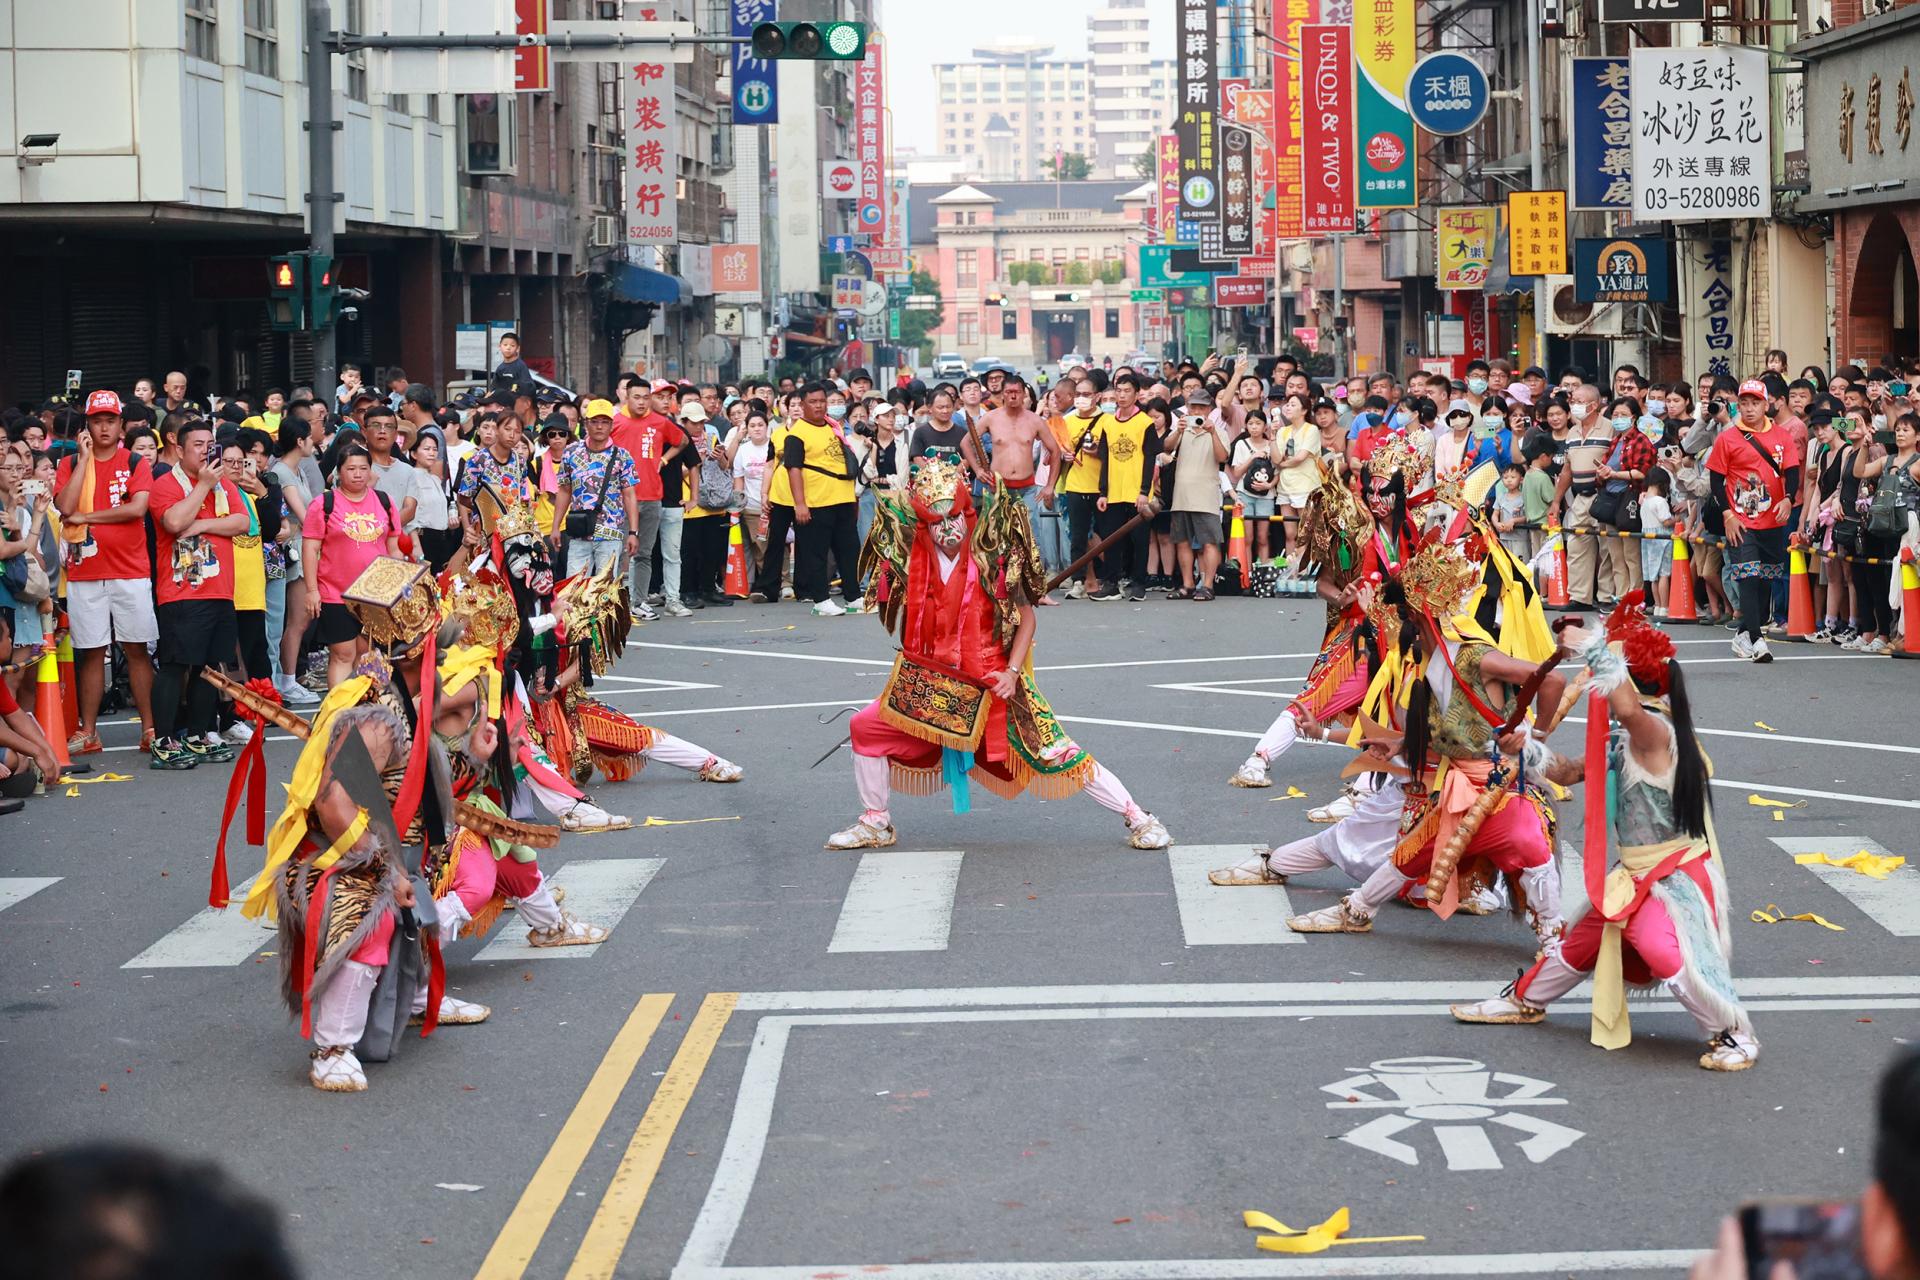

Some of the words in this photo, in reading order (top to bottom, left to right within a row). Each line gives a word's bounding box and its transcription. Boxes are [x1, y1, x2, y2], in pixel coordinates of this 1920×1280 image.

[1315, 31, 1338, 110] UNION
[1658, 56, 1741, 92] 好豆味
[1424, 75, 1472, 98] 禾楓
[633, 9, 667, 217] 和裝璜行
[1321, 112, 1339, 132] &
[1641, 96, 1763, 145] 冰沙豆花
[830, 173, 855, 187] SYM
[1322, 138, 1341, 193] TWO
[1652, 155, 1751, 178] 外送專線
[1365, 180, 1407, 190] 台灣彩券
[1645, 185, 1761, 210] 03-5280986
[630, 226, 672, 238] 5224056
[1530, 195, 1542, 271] 技執法取締
[1547, 195, 1559, 271] 本路段有科
